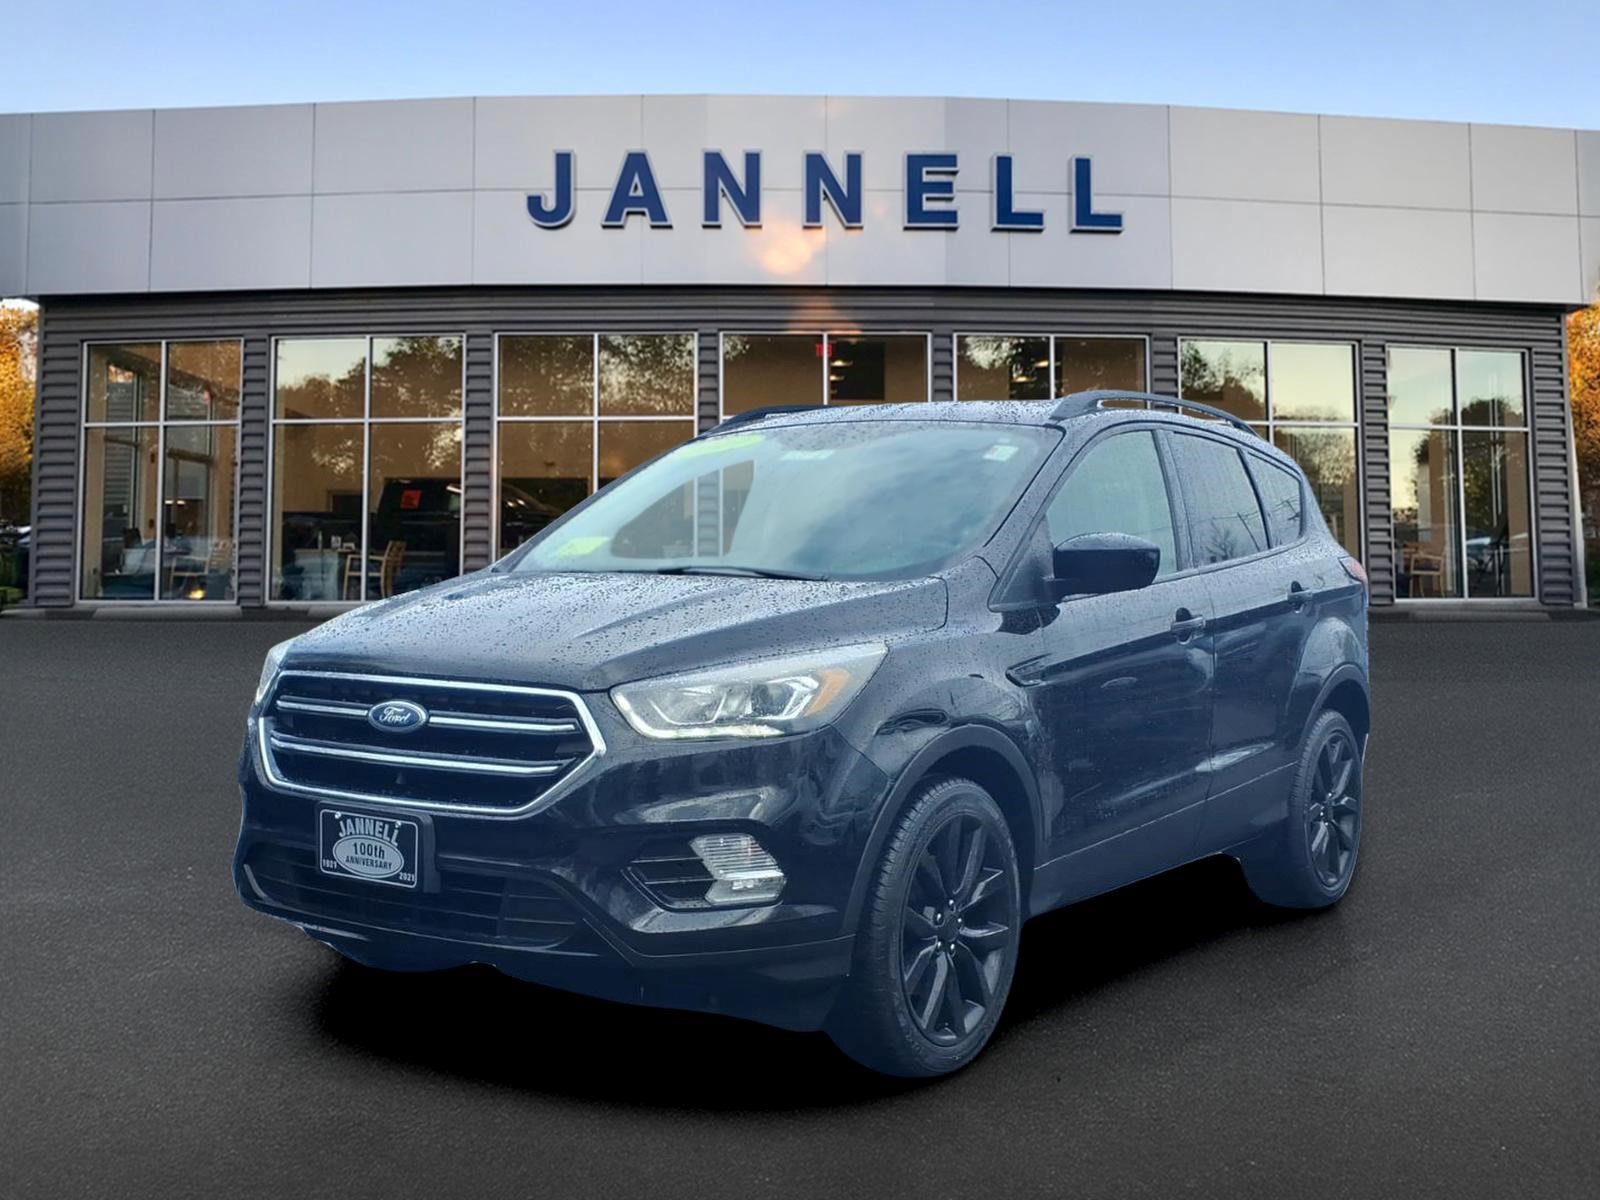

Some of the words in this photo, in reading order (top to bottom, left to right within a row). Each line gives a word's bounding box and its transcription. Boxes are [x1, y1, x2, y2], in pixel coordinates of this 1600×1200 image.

[526, 149, 1123, 233] JANNELL
[379, 706, 411, 723] Ford
[339, 818, 399, 846] JANNELL
[353, 842, 385, 860] 100th
[345, 855, 393, 870] ANNIVERSARY
